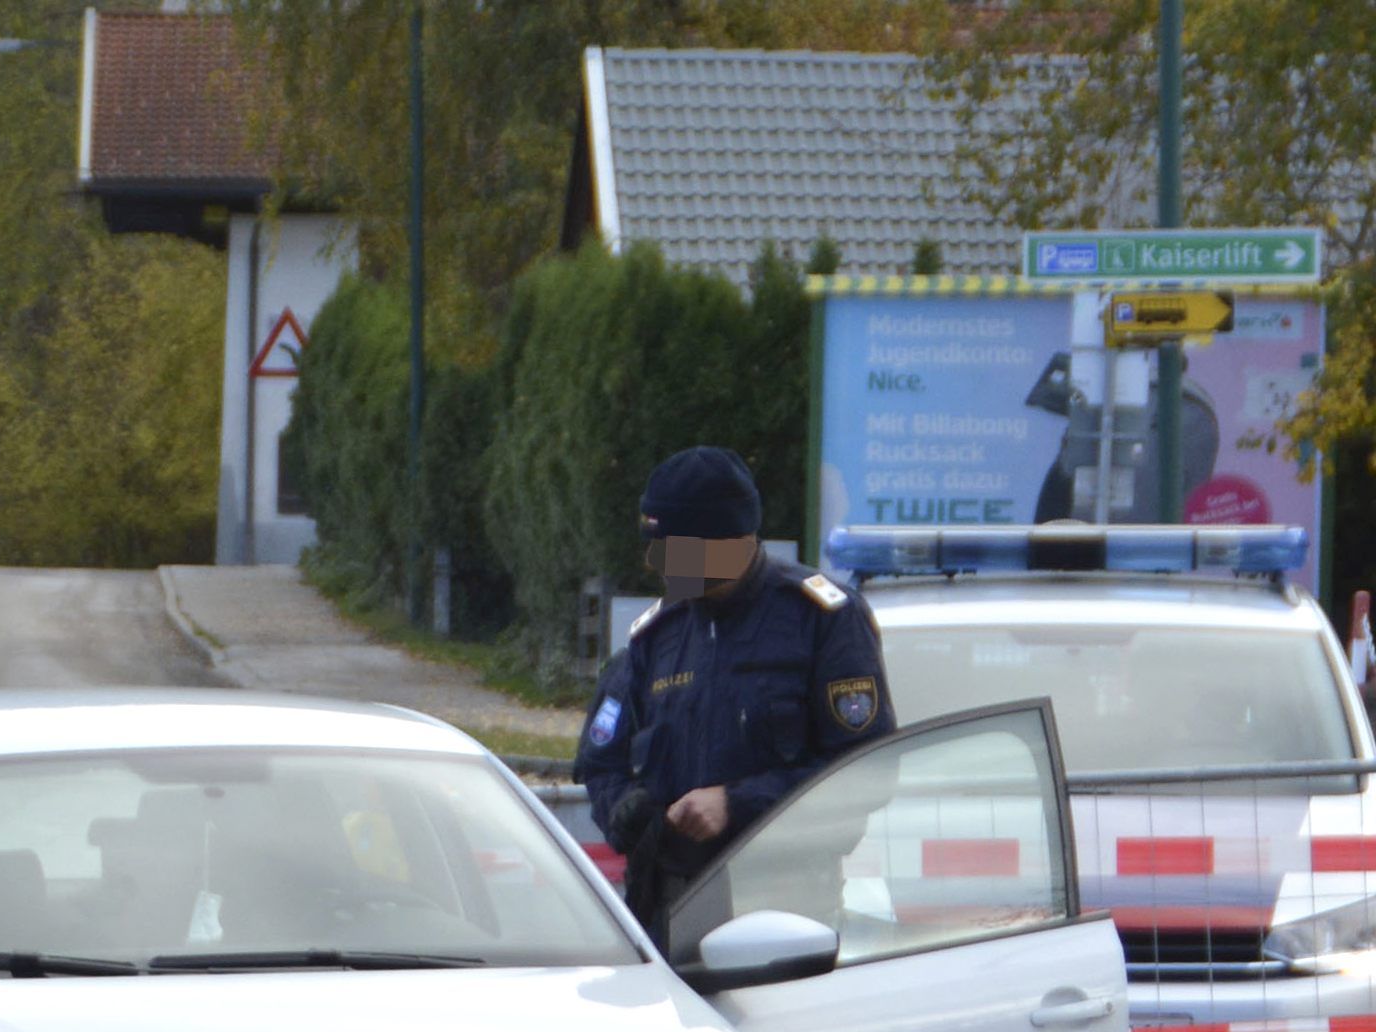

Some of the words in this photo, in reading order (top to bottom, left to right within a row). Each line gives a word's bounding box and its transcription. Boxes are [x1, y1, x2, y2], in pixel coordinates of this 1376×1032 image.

[1141, 241, 1263, 269] Kaiserlift
[868, 313, 1014, 336] Modernstes
[867, 371, 926, 392] Nice.
[866, 413, 906, 436] Mit
[912, 413, 1028, 440] Billabong
[866, 440, 985, 462] Rucksack
[866, 471, 936, 493] gratis
[867, 498, 1015, 523] TWICE
[652, 671, 695, 694] POLIZEI
